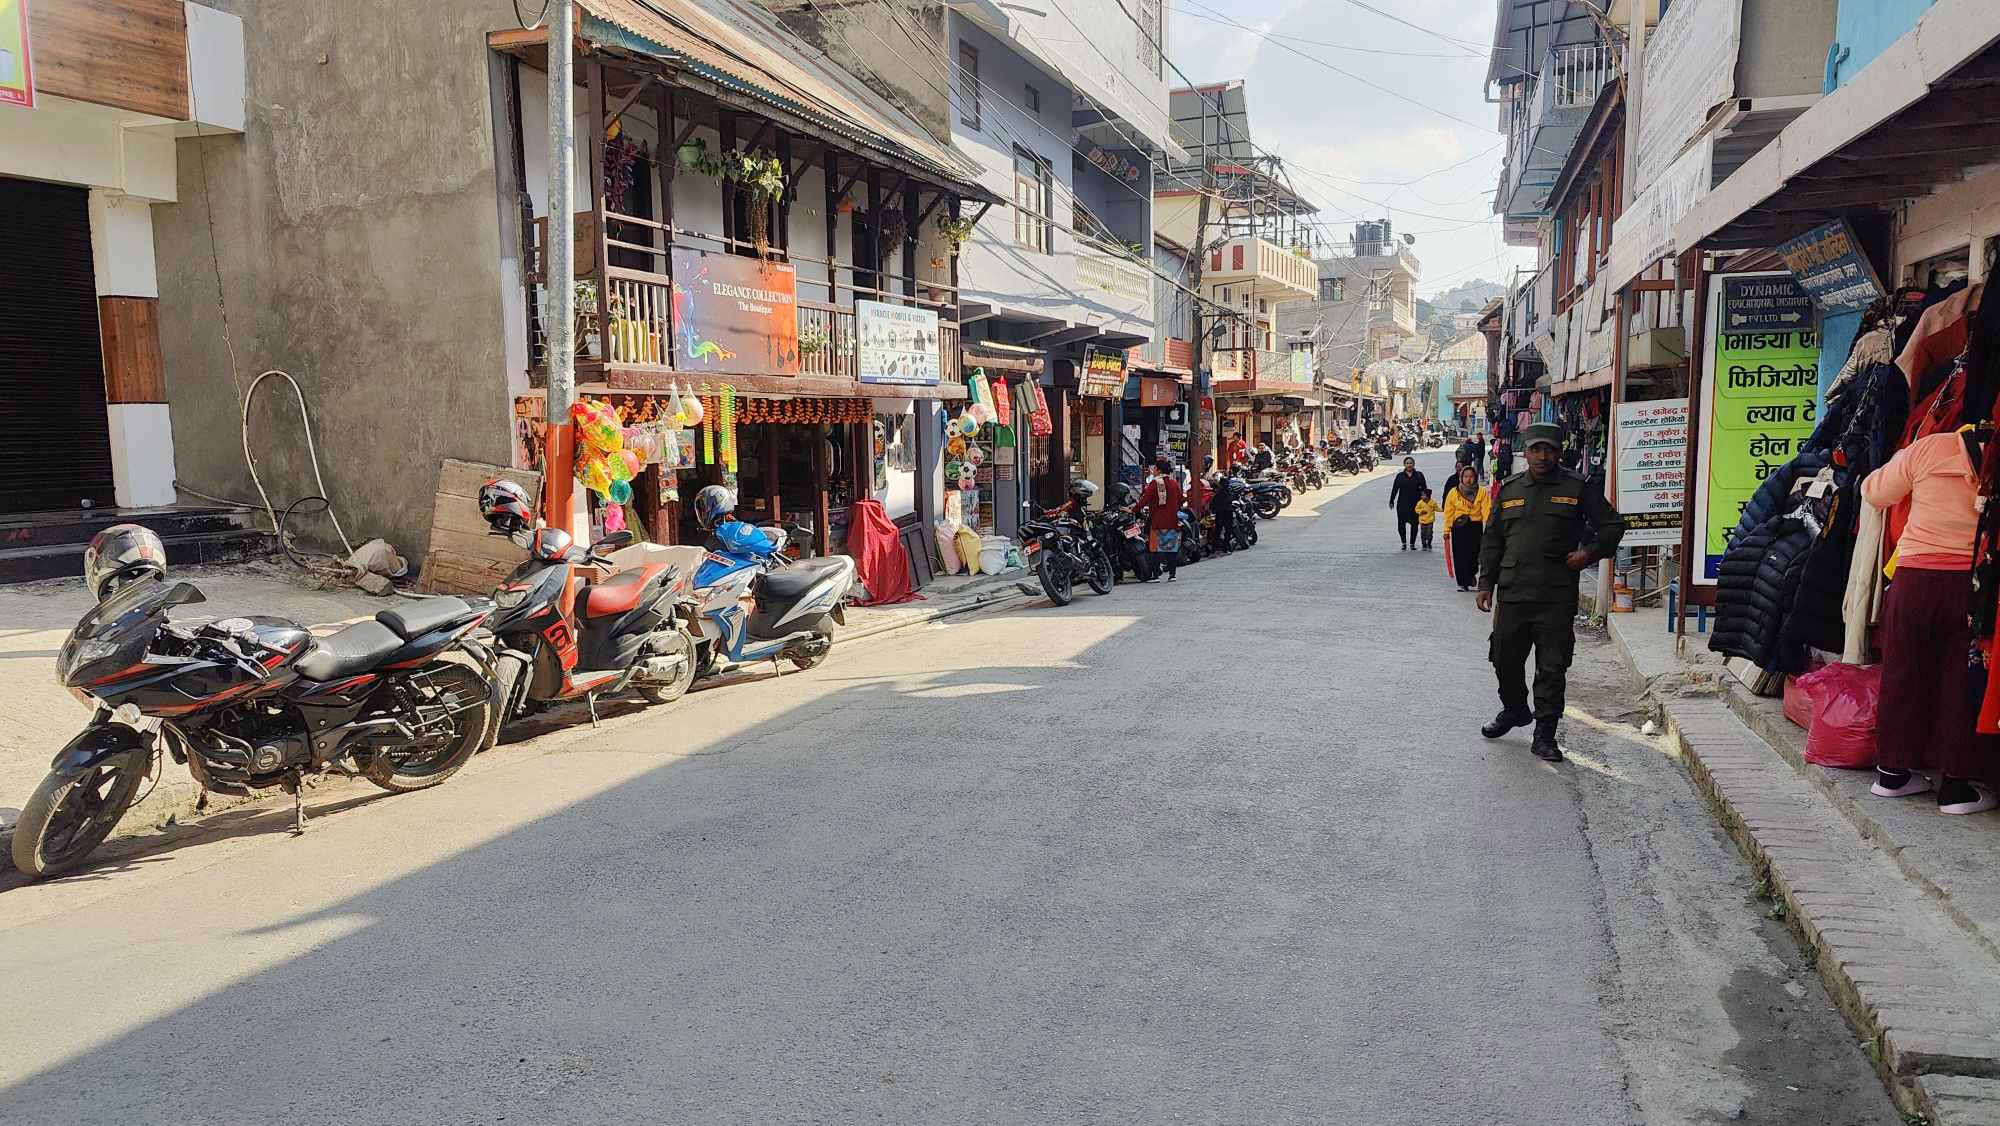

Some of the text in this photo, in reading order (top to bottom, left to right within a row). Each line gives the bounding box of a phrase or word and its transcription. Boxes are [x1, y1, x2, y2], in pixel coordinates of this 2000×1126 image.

[713, 282, 793, 304] ELEGANCE COLLECTION
[1740, 284, 1794, 297] DYNAMIC
[738, 301, 773, 316] The Boutique
[1728, 297, 1808, 309] EDUCATIONAL INSTITUTE
[1746, 404, 1796, 424] ल्याव
[1749, 433, 1791, 457] होल
